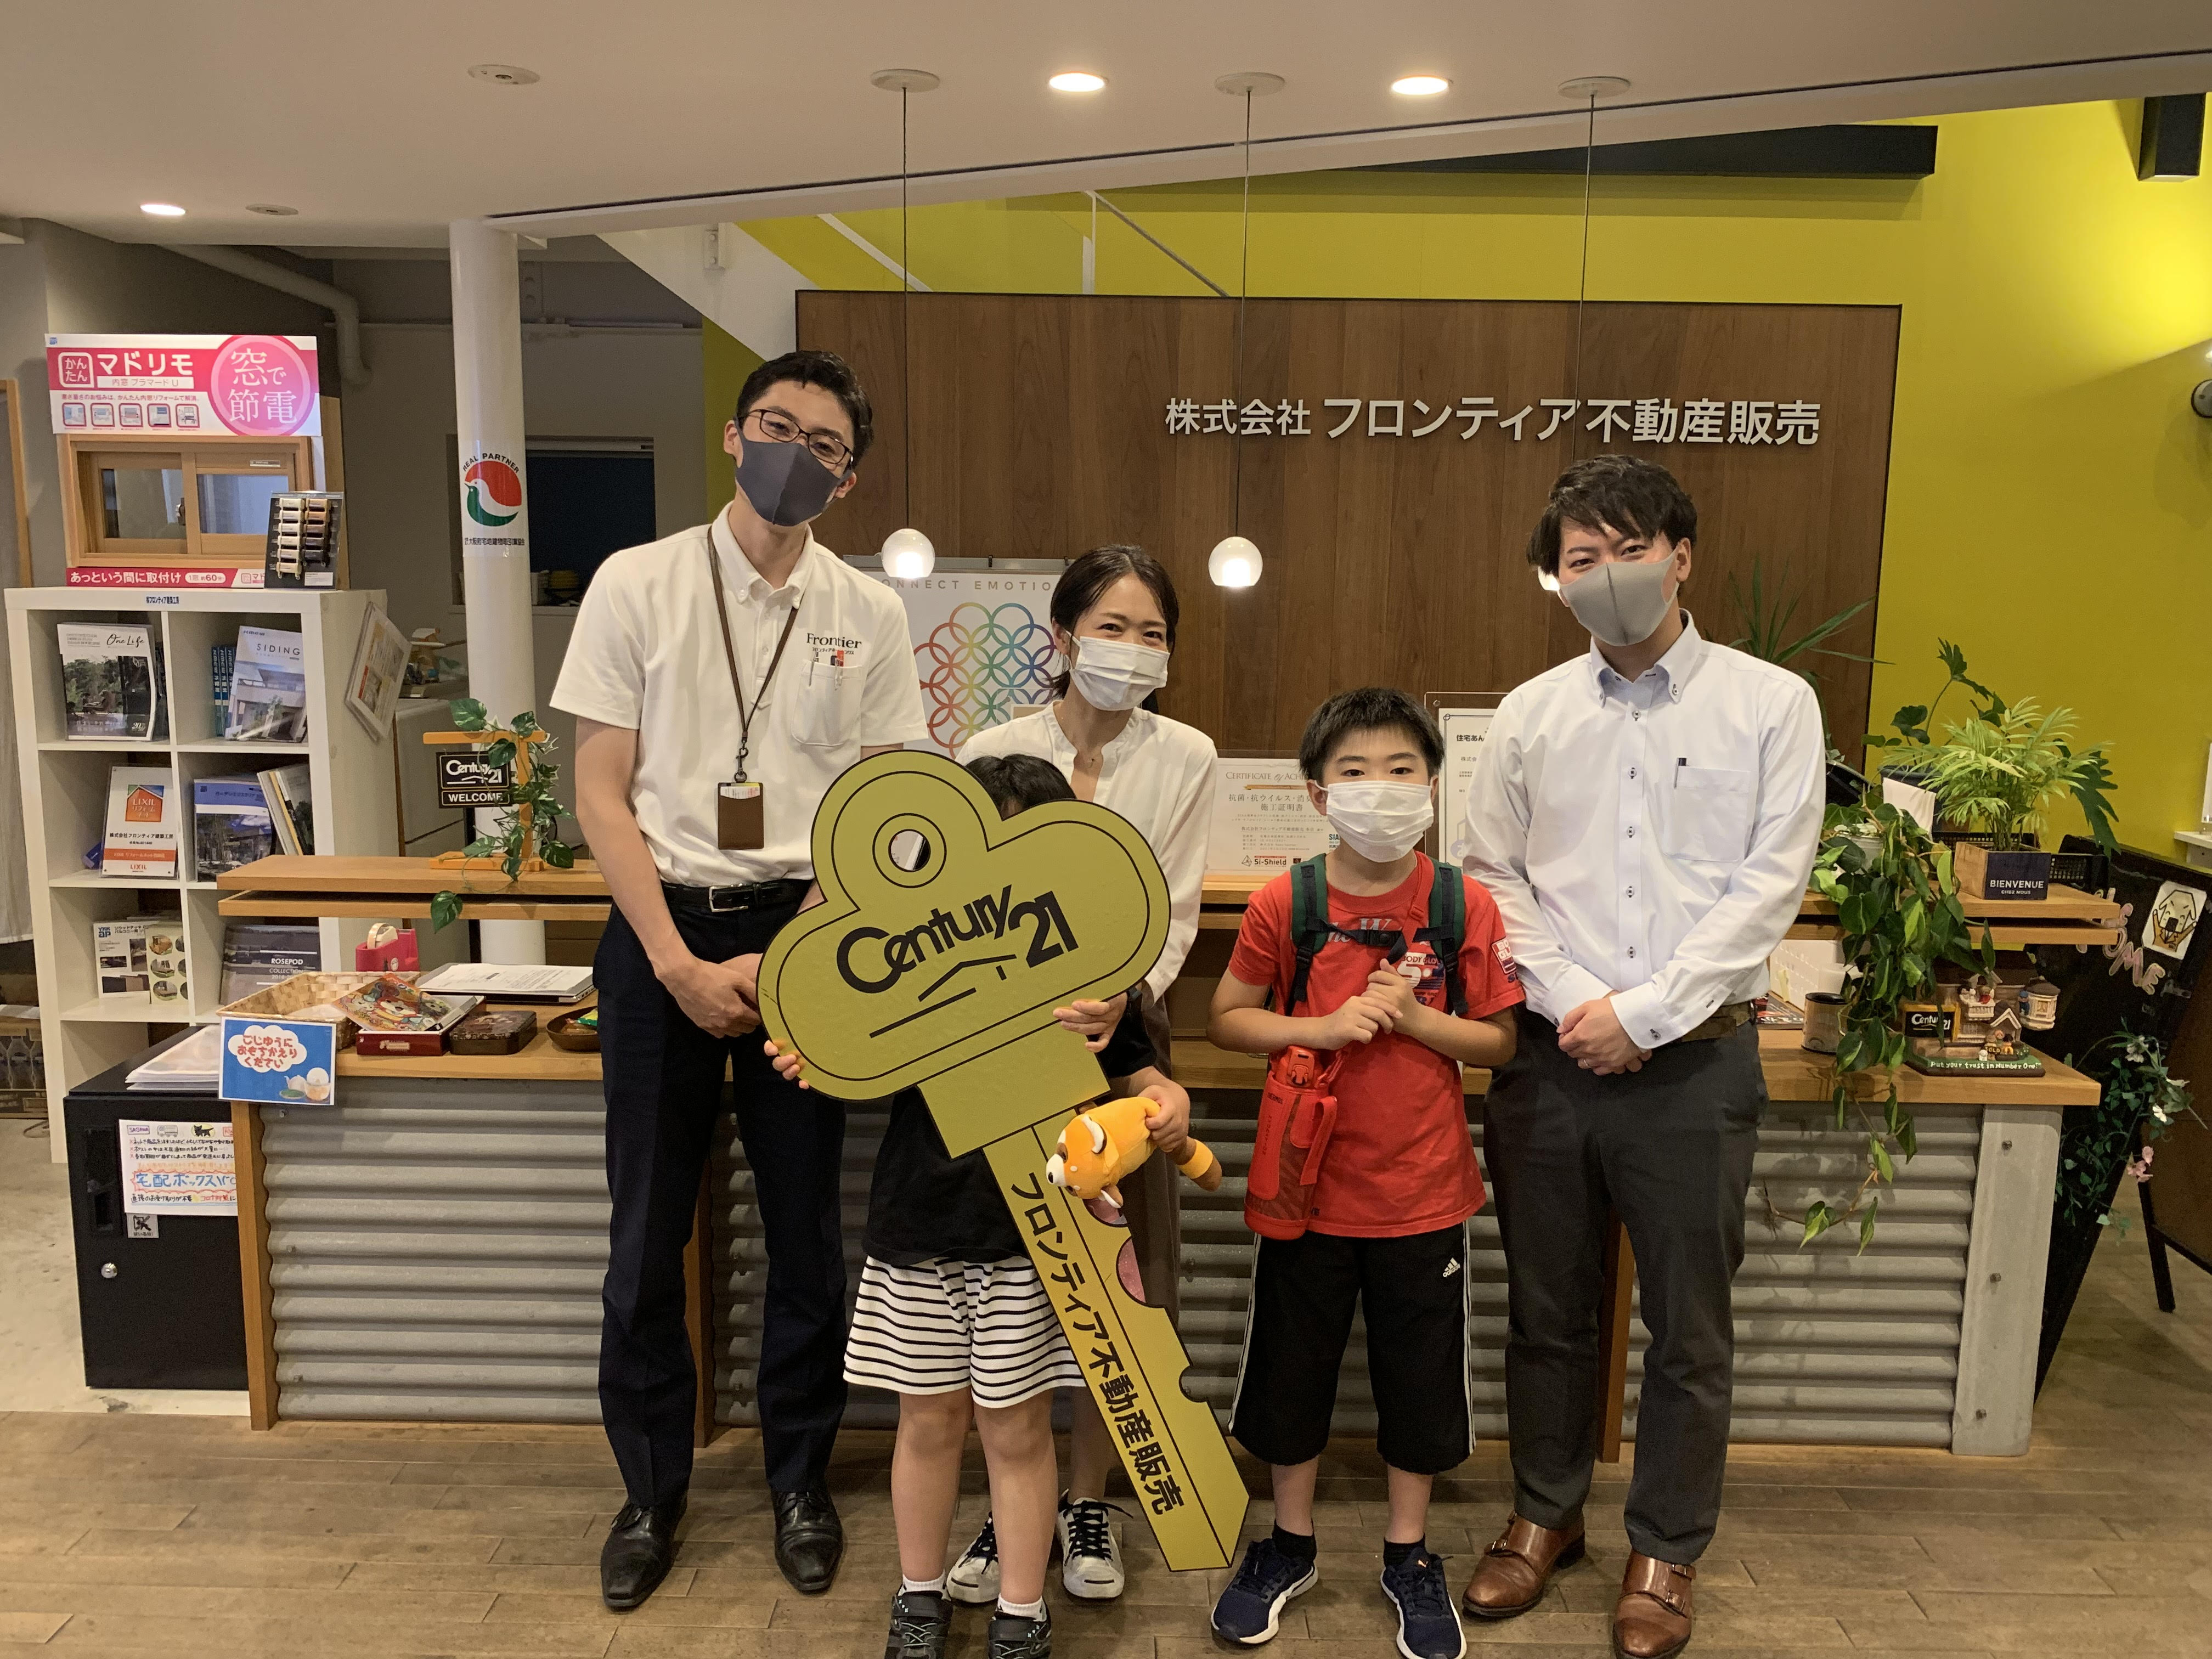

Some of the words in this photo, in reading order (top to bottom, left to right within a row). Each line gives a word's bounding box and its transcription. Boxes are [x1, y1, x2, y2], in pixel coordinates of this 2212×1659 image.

[65, 358, 87, 370] かん
[97, 351, 193, 376] マドリモ
[230, 348, 287, 386] 窓で
[65, 370, 88, 382] たん
[228, 388, 297, 424] 節電
[1165, 397, 1311, 437] 株式会社
[1323, 397, 1821, 446] フロンティア不動産販売
[463, 455, 479, 472] REAL
[482, 453, 520, 473] PARTNER
[70, 571, 181, 584] あっという間に取付け
[882, 579, 960, 590] ONNECT
[974, 580, 1051, 591] EMOTIO
[106, 633, 126, 646] One
[126, 635, 145, 648] Life
[806, 633, 862, 648] Frontier
[256, 643, 301, 656] SIDING
[487, 769, 503, 783] 21
[1226, 771, 1272, 780] CERTIFICATE
[1989, 879, 2045, 889] BIENVENUE
[836, 884, 1013, 995] Century
[1008, 890, 1079, 968] 21
[237, 1045, 297, 1059] おもちかえり
[245, 1056, 284, 1068] ください
[1011, 1171, 1184, 1516] フロンティア不動産販売
